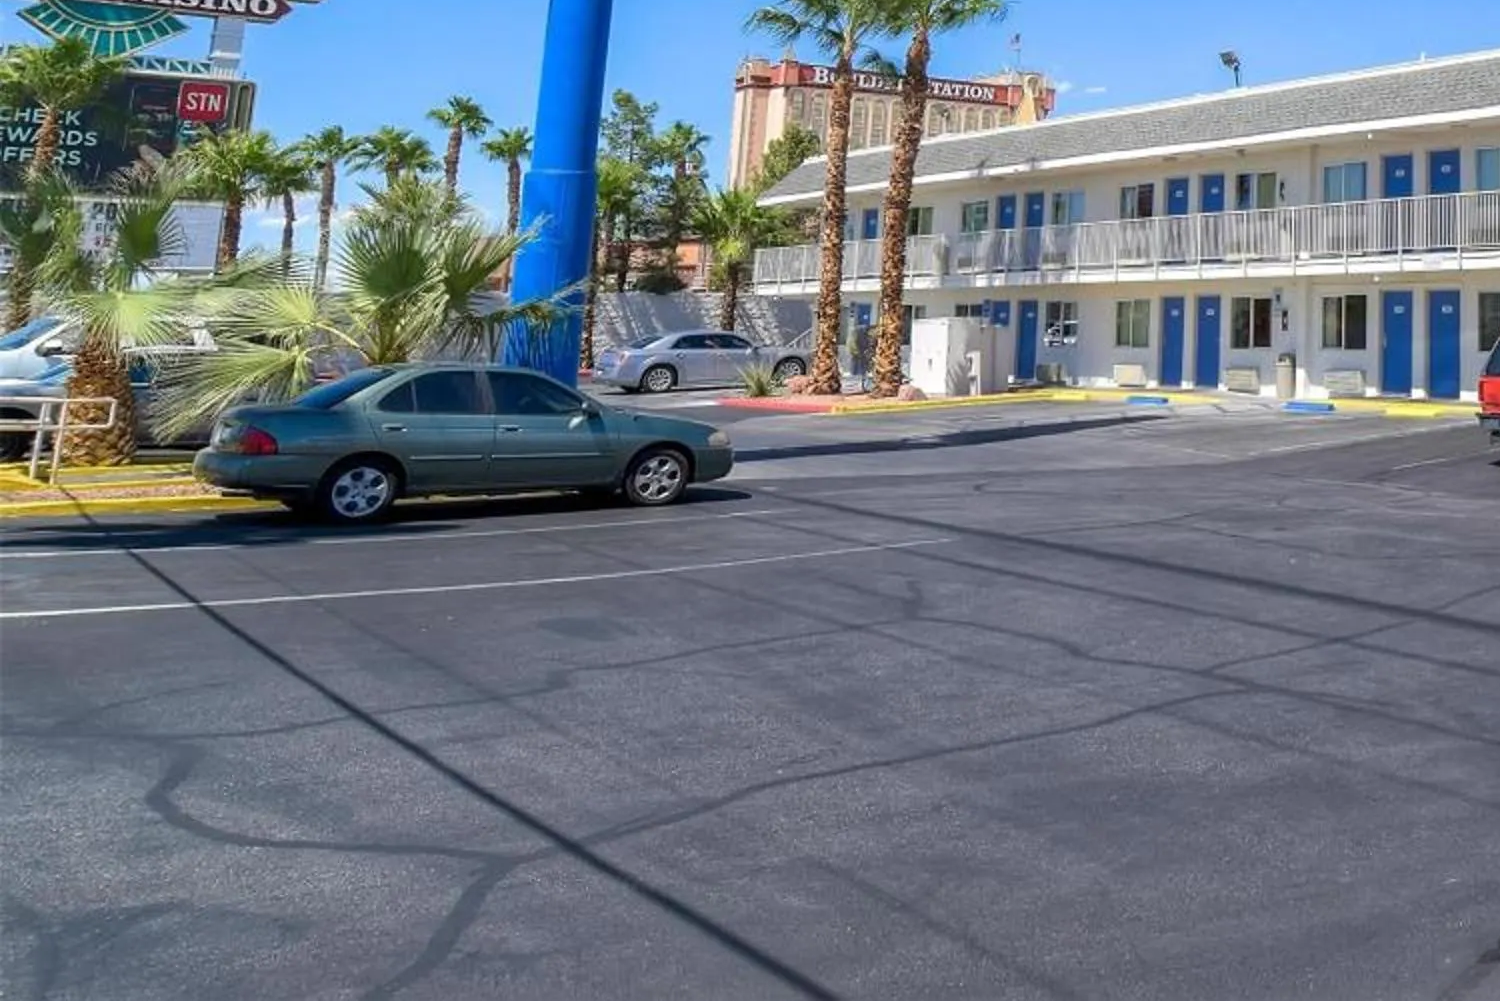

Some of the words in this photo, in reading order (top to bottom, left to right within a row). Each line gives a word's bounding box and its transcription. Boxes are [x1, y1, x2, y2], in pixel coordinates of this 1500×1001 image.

[926, 80, 996, 101] TATION
[184, 91, 222, 112] STN
[0, 105, 82, 126] CHEK
[0, 146, 82, 166] FFRS
